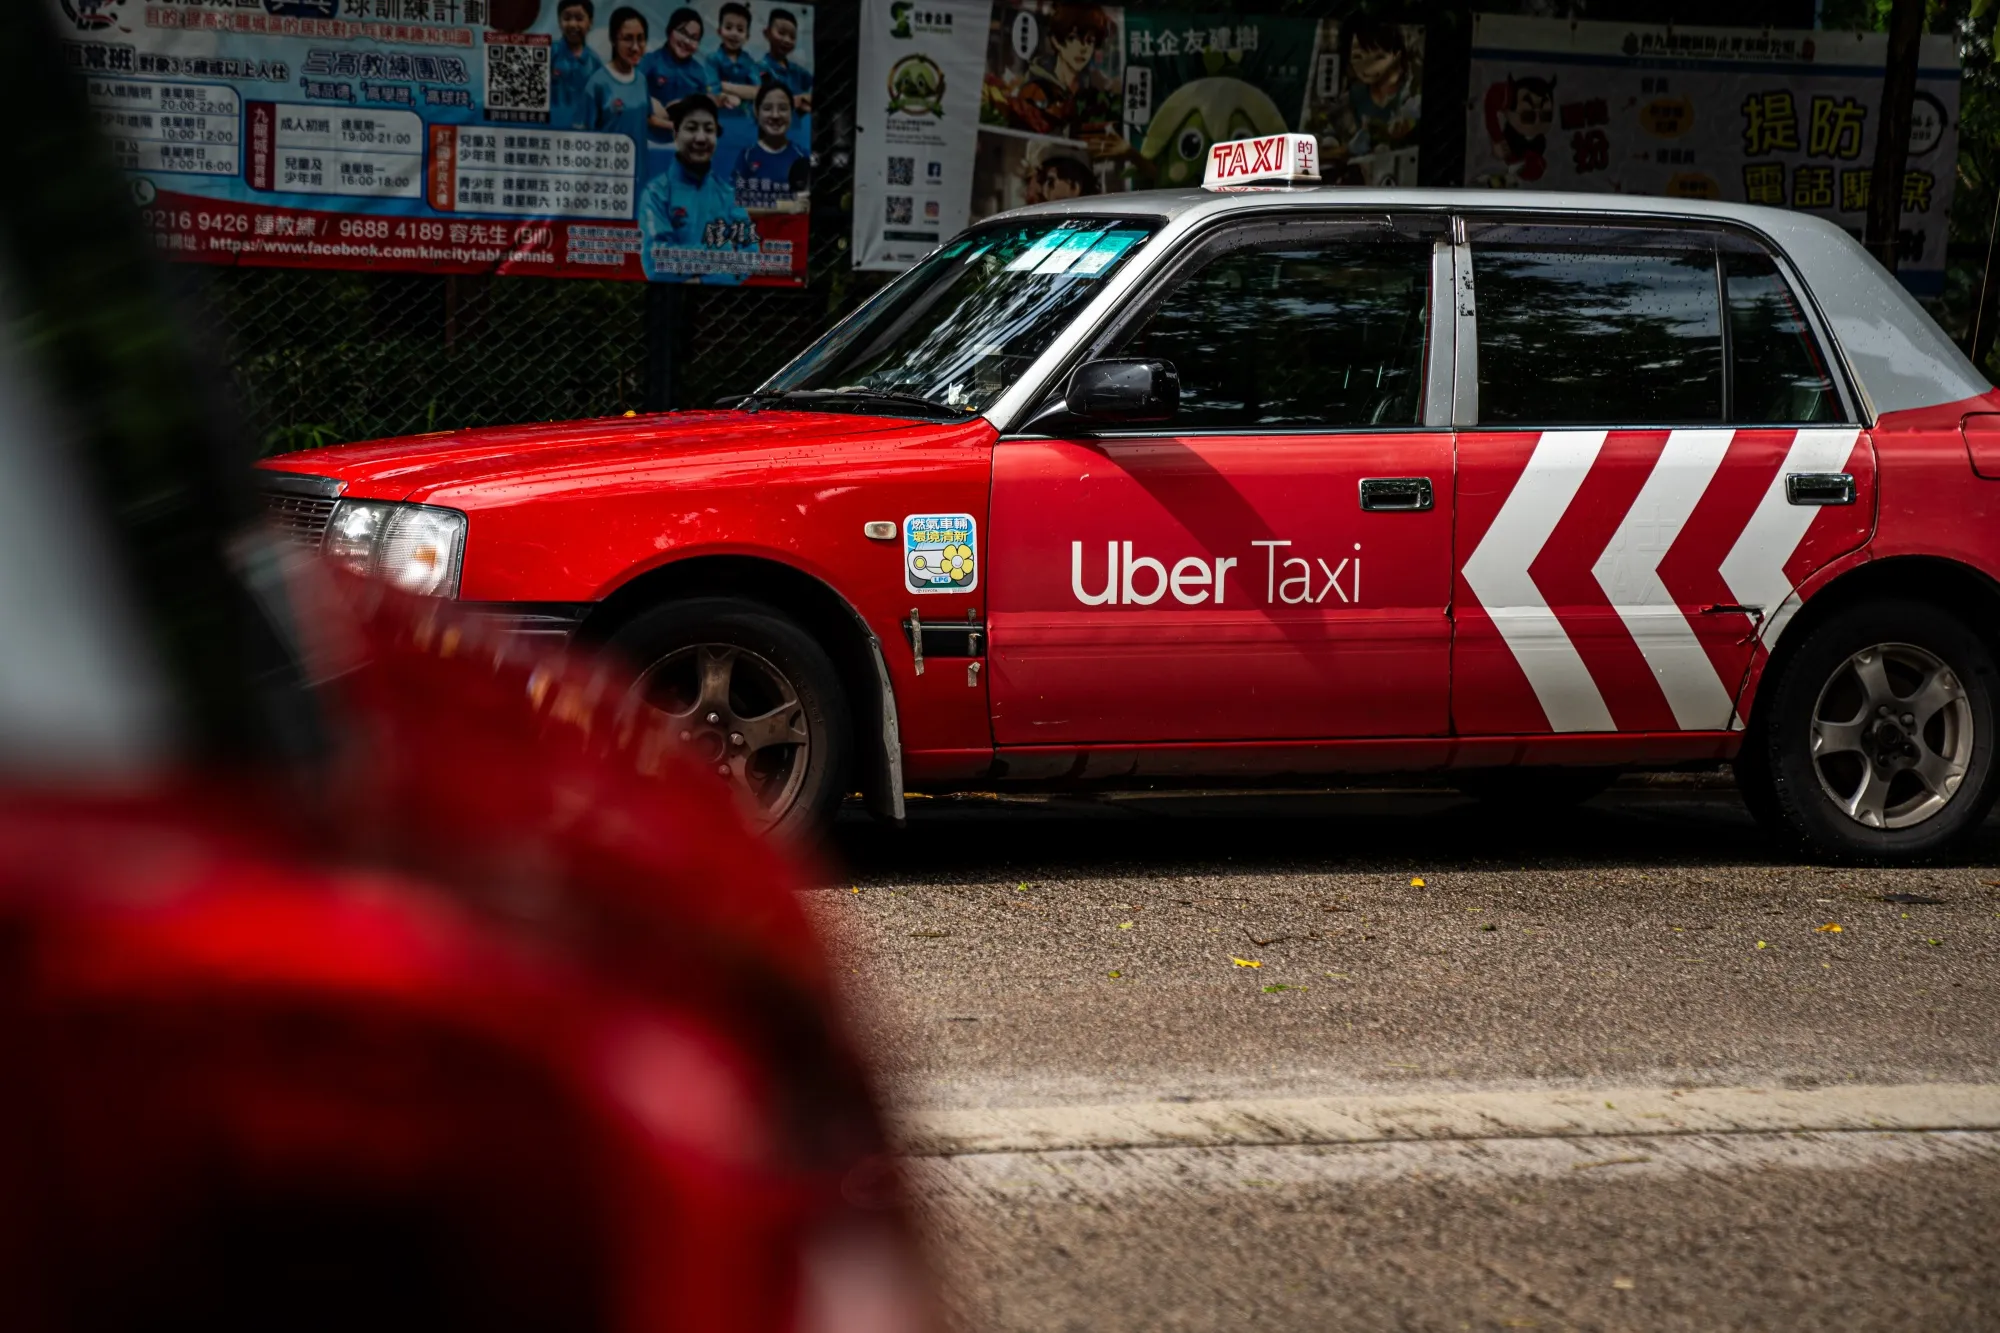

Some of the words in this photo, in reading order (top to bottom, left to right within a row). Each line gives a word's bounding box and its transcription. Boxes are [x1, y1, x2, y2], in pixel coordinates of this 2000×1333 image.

[161, 100, 233, 113] 20:00-22:00
[1742, 91, 1866, 160] 提防
[162, 130, 233, 143] 10:00-12:00
[342, 132, 411, 144] 19:00-21:00
[556, 140, 629, 154] 18:00-20:00
[1214, 137, 1285, 178] TAXI
[1298, 140, 1313, 169] 的士
[556, 155, 629, 170] 15:00-21:00
[341, 175, 409, 188] 16:00-18:00
[555, 180, 628, 195] 20:00-22:00
[556, 197, 627, 211] 13:00-15:00
[142, 209, 192, 230] 9216
[197, 211, 249, 233] 9426
[339, 218, 389, 239] 9688
[395, 221, 445, 242] 4189
[449, 223, 508, 245] 容先生
[513, 227, 555, 250] (Bill)
[912, 518, 968, 530] 燃氣車輛
[914, 530, 967, 543] 環境清新
[1072, 541, 1237, 605] Uber
[1252, 540, 1361, 604] Taxi
